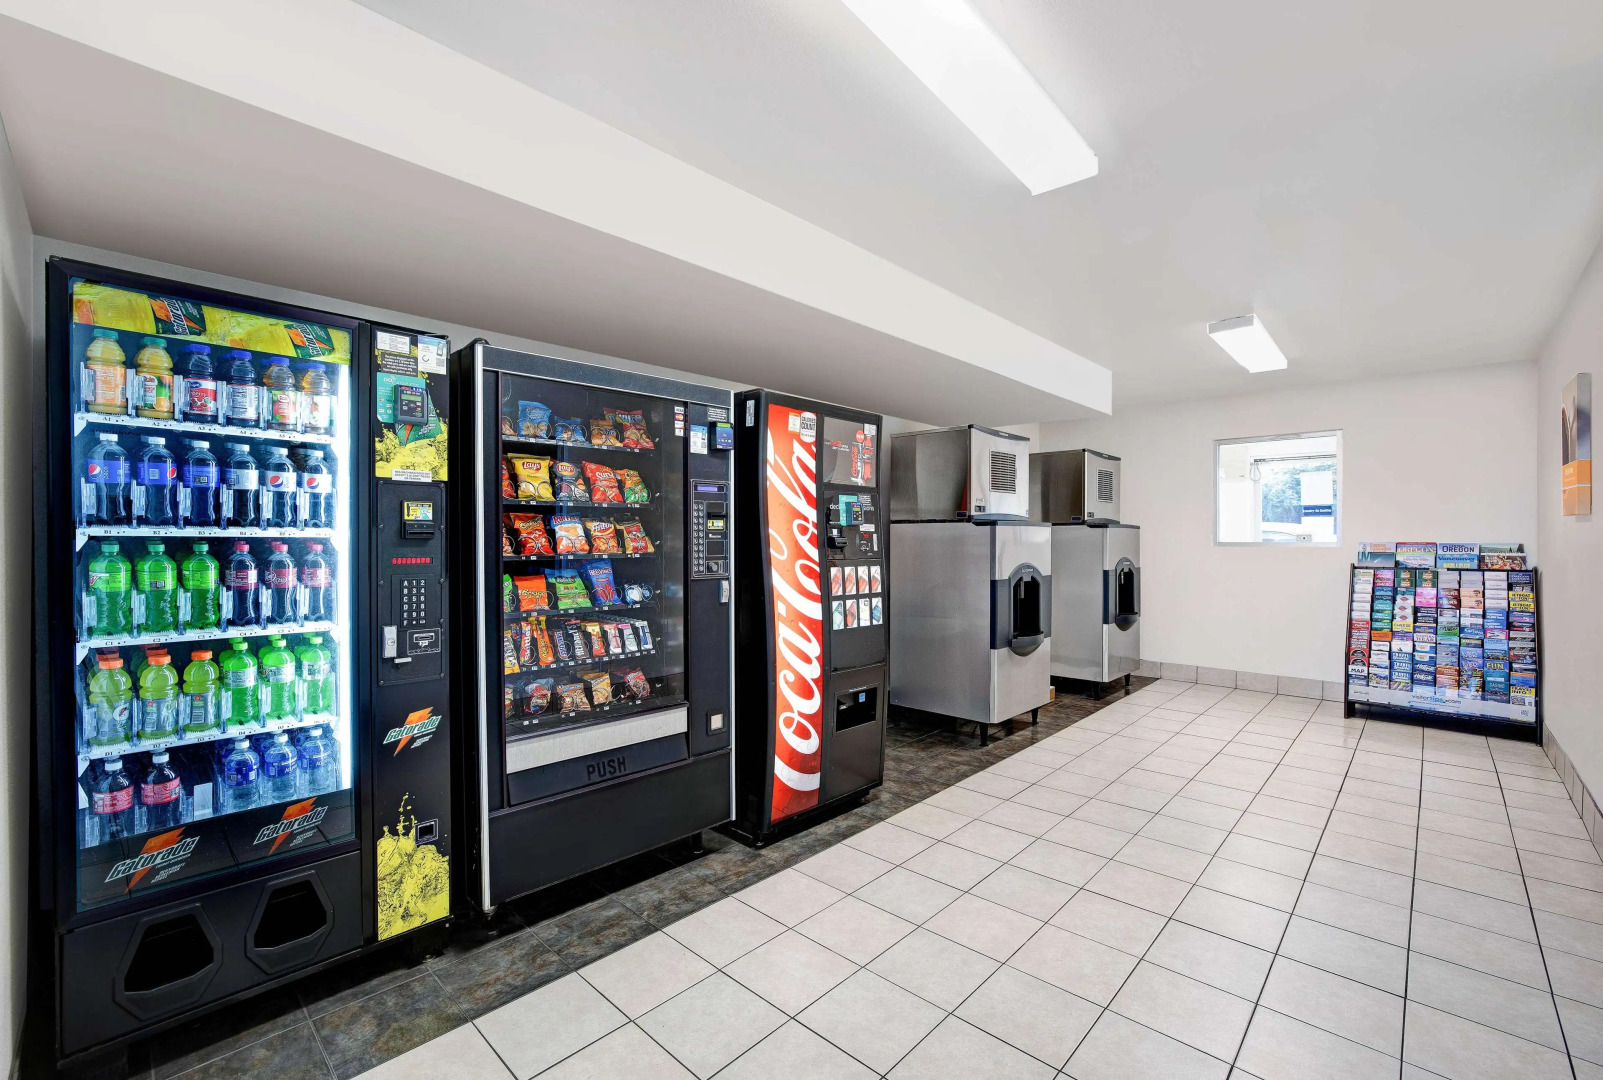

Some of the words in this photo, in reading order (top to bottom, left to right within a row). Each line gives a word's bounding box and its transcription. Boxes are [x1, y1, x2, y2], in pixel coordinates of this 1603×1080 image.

[802, 422, 816, 431] COUNT
[383, 715, 442, 744] Gatorade
[586, 756, 626, 781] PUSH
[253, 806, 328, 845] Gatorade
[104, 836, 200, 883] Gatorade
